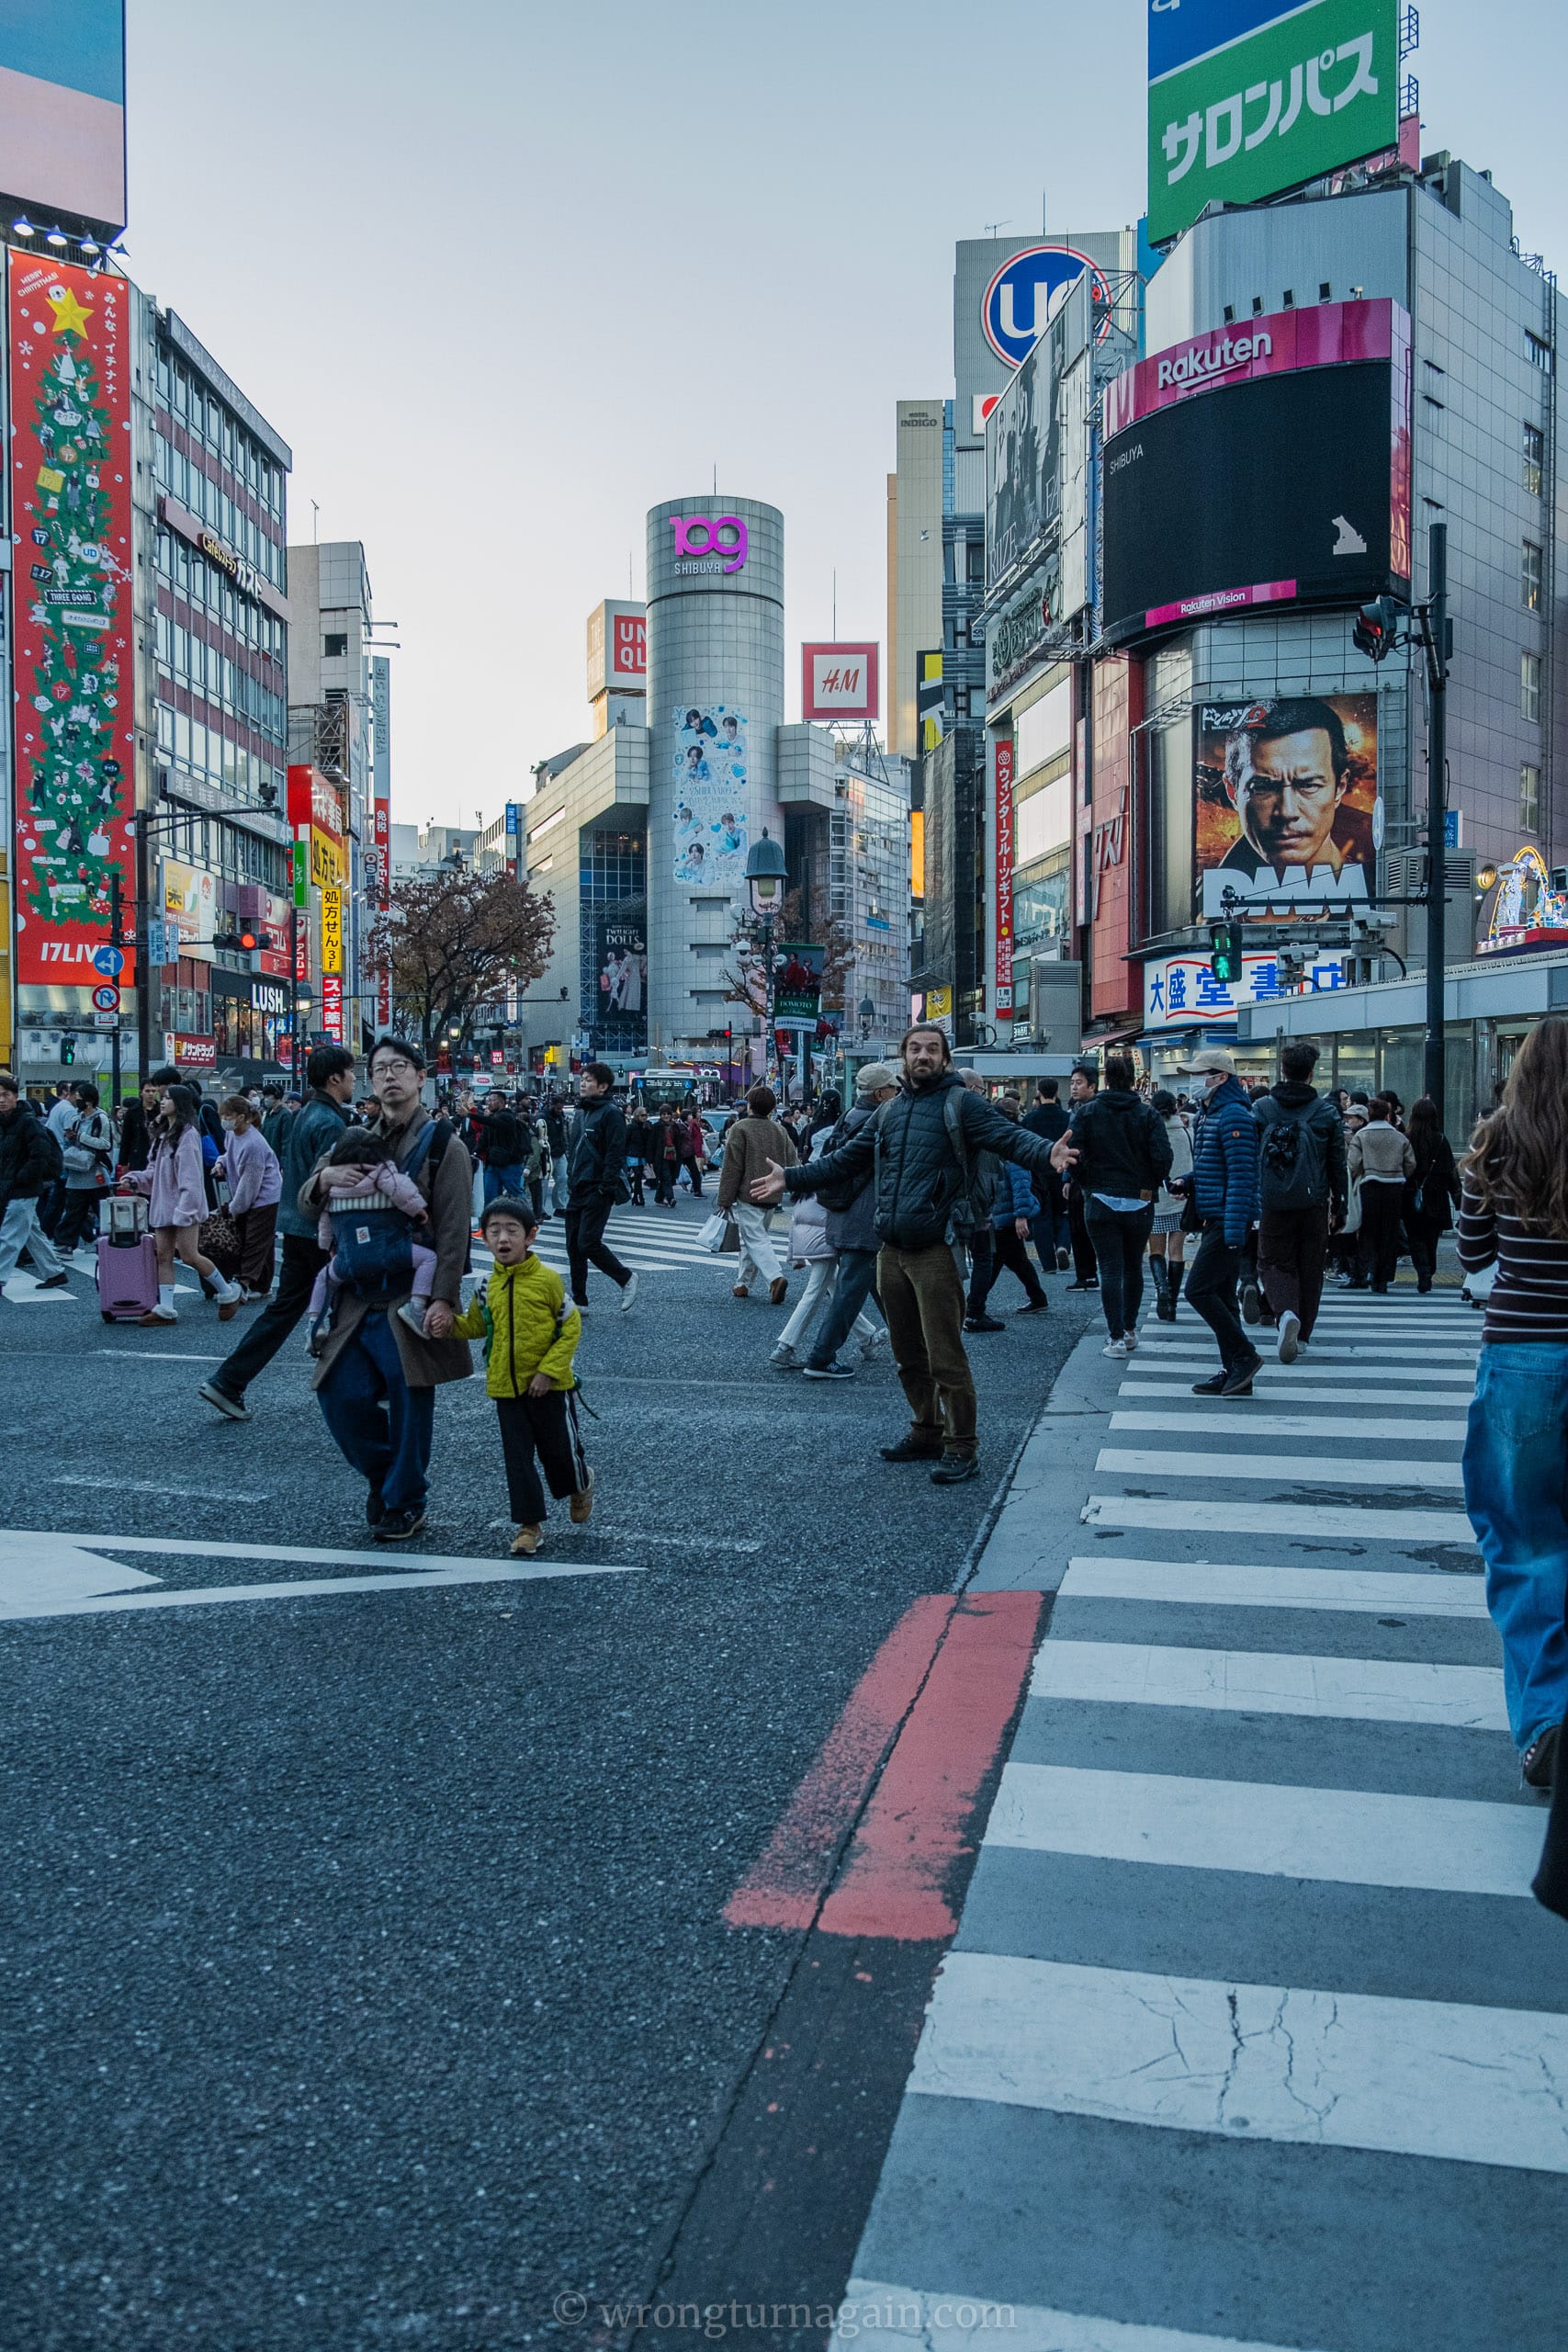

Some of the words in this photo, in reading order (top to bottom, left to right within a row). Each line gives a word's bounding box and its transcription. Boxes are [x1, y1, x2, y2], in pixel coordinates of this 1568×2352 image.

[1161, 30, 1379, 186] サロンパス
[103, 291, 118, 403] みんな、イチナナ。
[1157, 332, 1272, 390] Rakuten
[900, 418, 937, 427] INDIGO
[1109, 444, 1144, 475] SHIBUYA
[669, 516, 749, 573] 109
[991, 521, 1018, 579] RIIZE
[674, 562, 721, 574] SHIBUYA
[51, 593, 71, 602] THREE
[73, 593, 92, 602] GONG
[1180, 598, 1215, 614] Rakuten
[1216, 592, 1246, 604] Vision
[620, 623, 646, 641] UN
[620, 647, 646, 669] QL
[375, 665, 387, 690] BIC
[822, 668, 860, 694] H&M
[375, 695, 387, 755] CAMERA
[998, 766, 1011, 924] ウィンターフルーツギフト
[1202, 863, 1371, 918] DMM
[324, 890, 339, 947] 処方せん
[606, 934, 640, 945] DOLLS
[40, 943, 111, 964] 17LIV
[296, 943, 305, 969] アコム
[328, 950, 336, 970] 3F
[252, 983, 284, 1014] LUSH
[323, 978, 341, 1039] スギ薬局
[780, 1001, 813, 1009] DOMOTO
